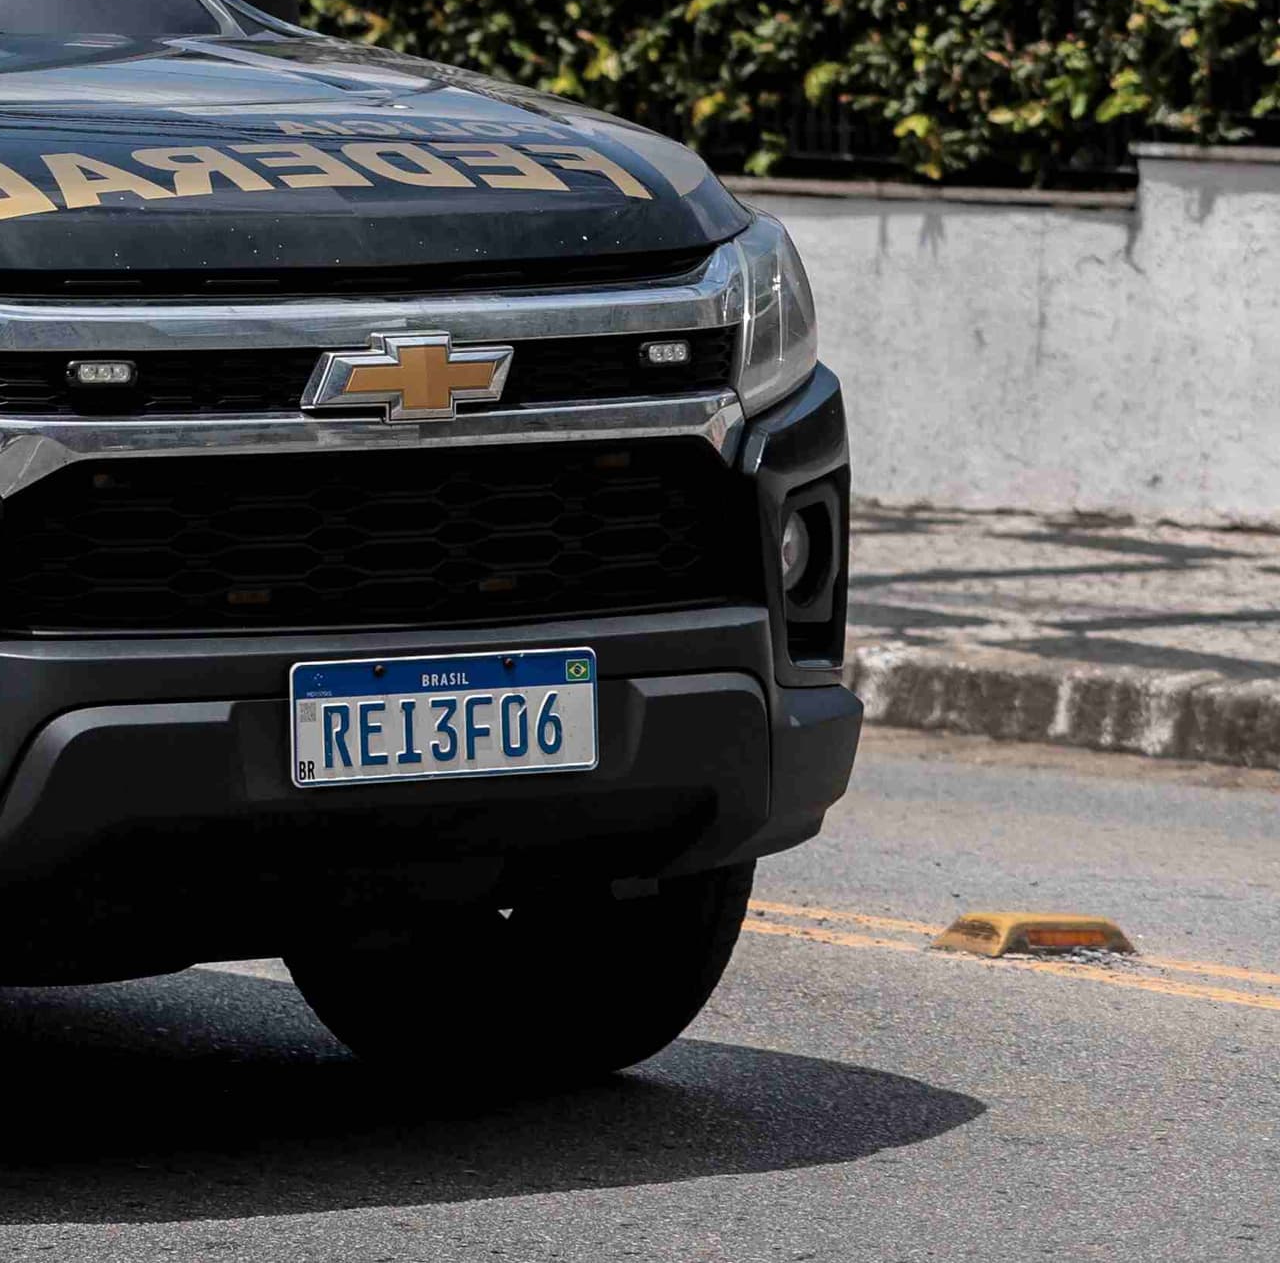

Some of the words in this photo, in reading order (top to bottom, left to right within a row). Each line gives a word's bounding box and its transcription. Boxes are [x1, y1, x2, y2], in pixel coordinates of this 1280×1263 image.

[421, 672, 470, 687] BRASIL
[321, 690, 564, 769] REI3F06
[299, 760, 316, 781] BR
